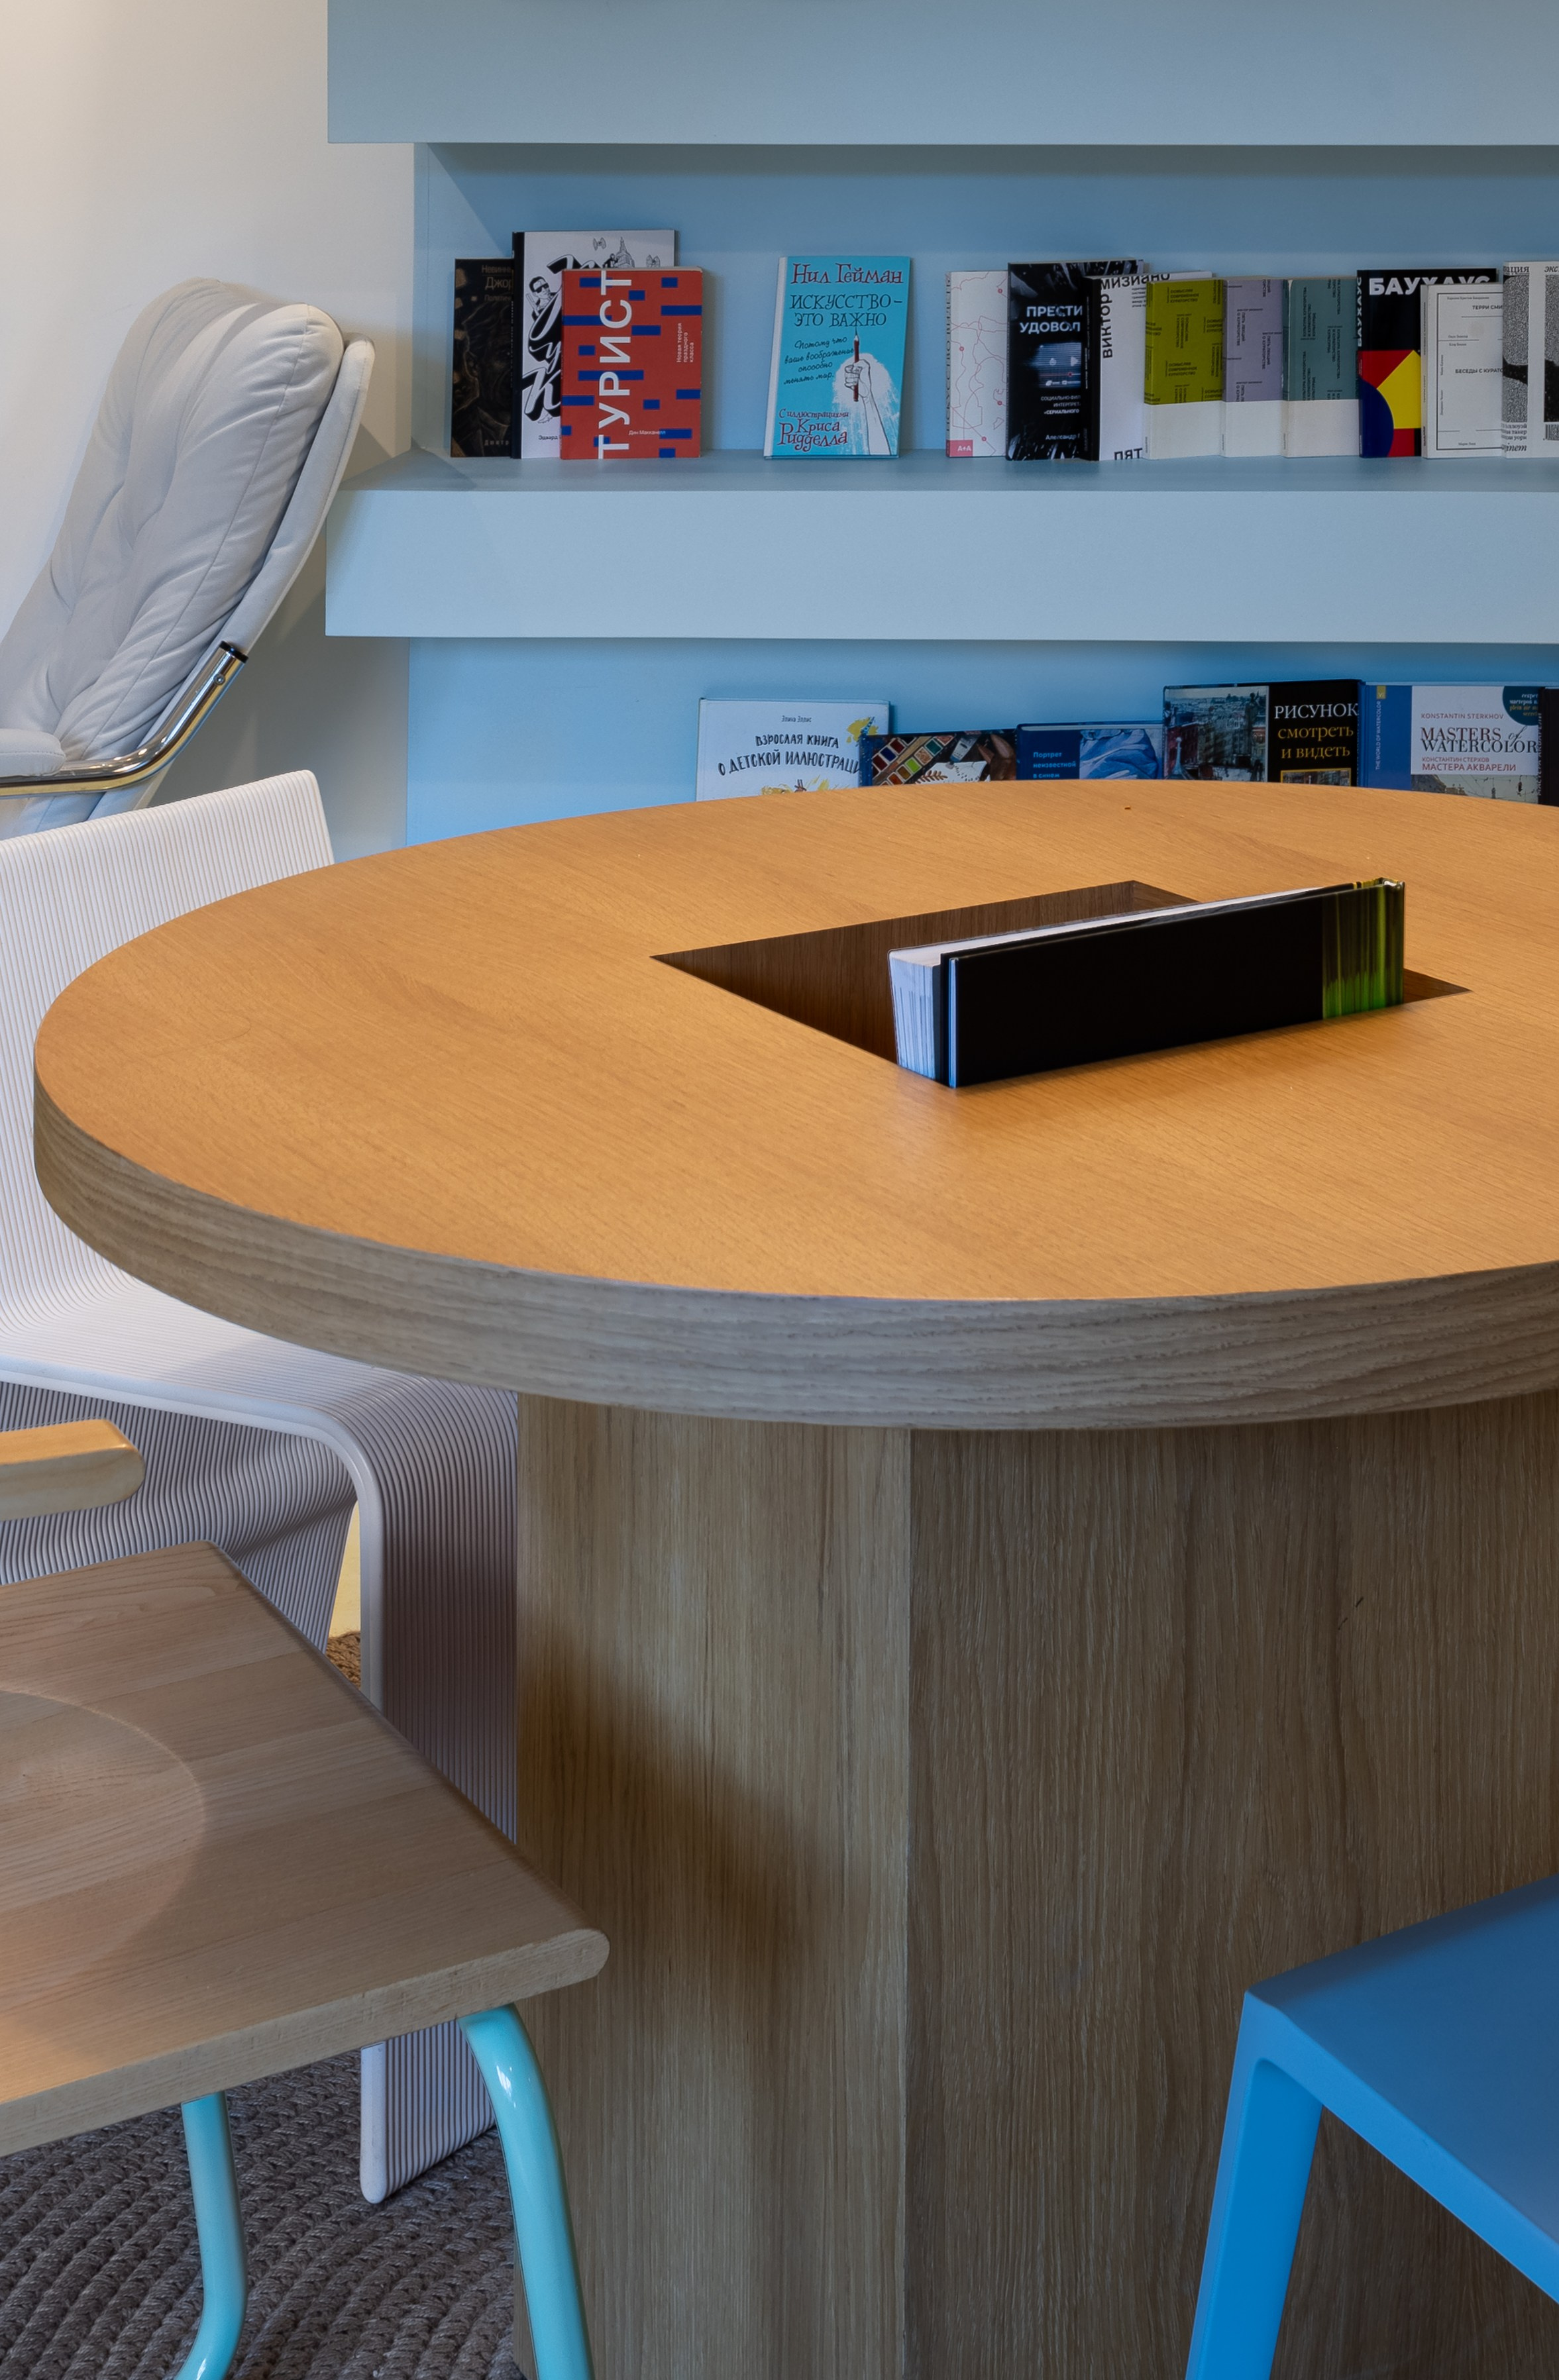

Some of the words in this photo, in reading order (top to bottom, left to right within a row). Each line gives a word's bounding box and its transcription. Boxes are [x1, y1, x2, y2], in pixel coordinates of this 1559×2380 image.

[790, 262, 831, 284] Нил
[835, 262, 904, 284] Гейман
[1027, 305, 1083, 318] ПРЕСТИ
[794, 312, 824, 327] ЭТО
[829, 312, 887, 328] ВАЖНО
[1020, 321, 1081, 335] УДОВОЛ
[794, 340, 830, 350] Потому
[598, 270, 633, 459] ТУРИСТ
[779, 408, 786, 418] С
[786, 411, 849, 420] иллюстрациями
[795, 418, 840, 435] Криса
[777, 422, 848, 452] Ридделла
[1273, 703, 1358, 719] РИСУНОК
[755, 733, 803, 747] ВЗРОСЛАЯ
[806, 735, 839, 749] КНИГА
[1277, 726, 1354, 742] смотреть
[1421, 727, 1501, 741] MASTERS
[1507, 725, 1528, 748] of
[1281, 749, 1291, 758] и
[1297, 747, 1350, 759] видеть
[1421, 739, 1538, 753] WATERCOLOR
[718, 763, 726, 776] О
[729, 749, 780, 774] ДЕТСКОЙ
[1466, 763, 1517, 772] АКВАРЕЛИ
